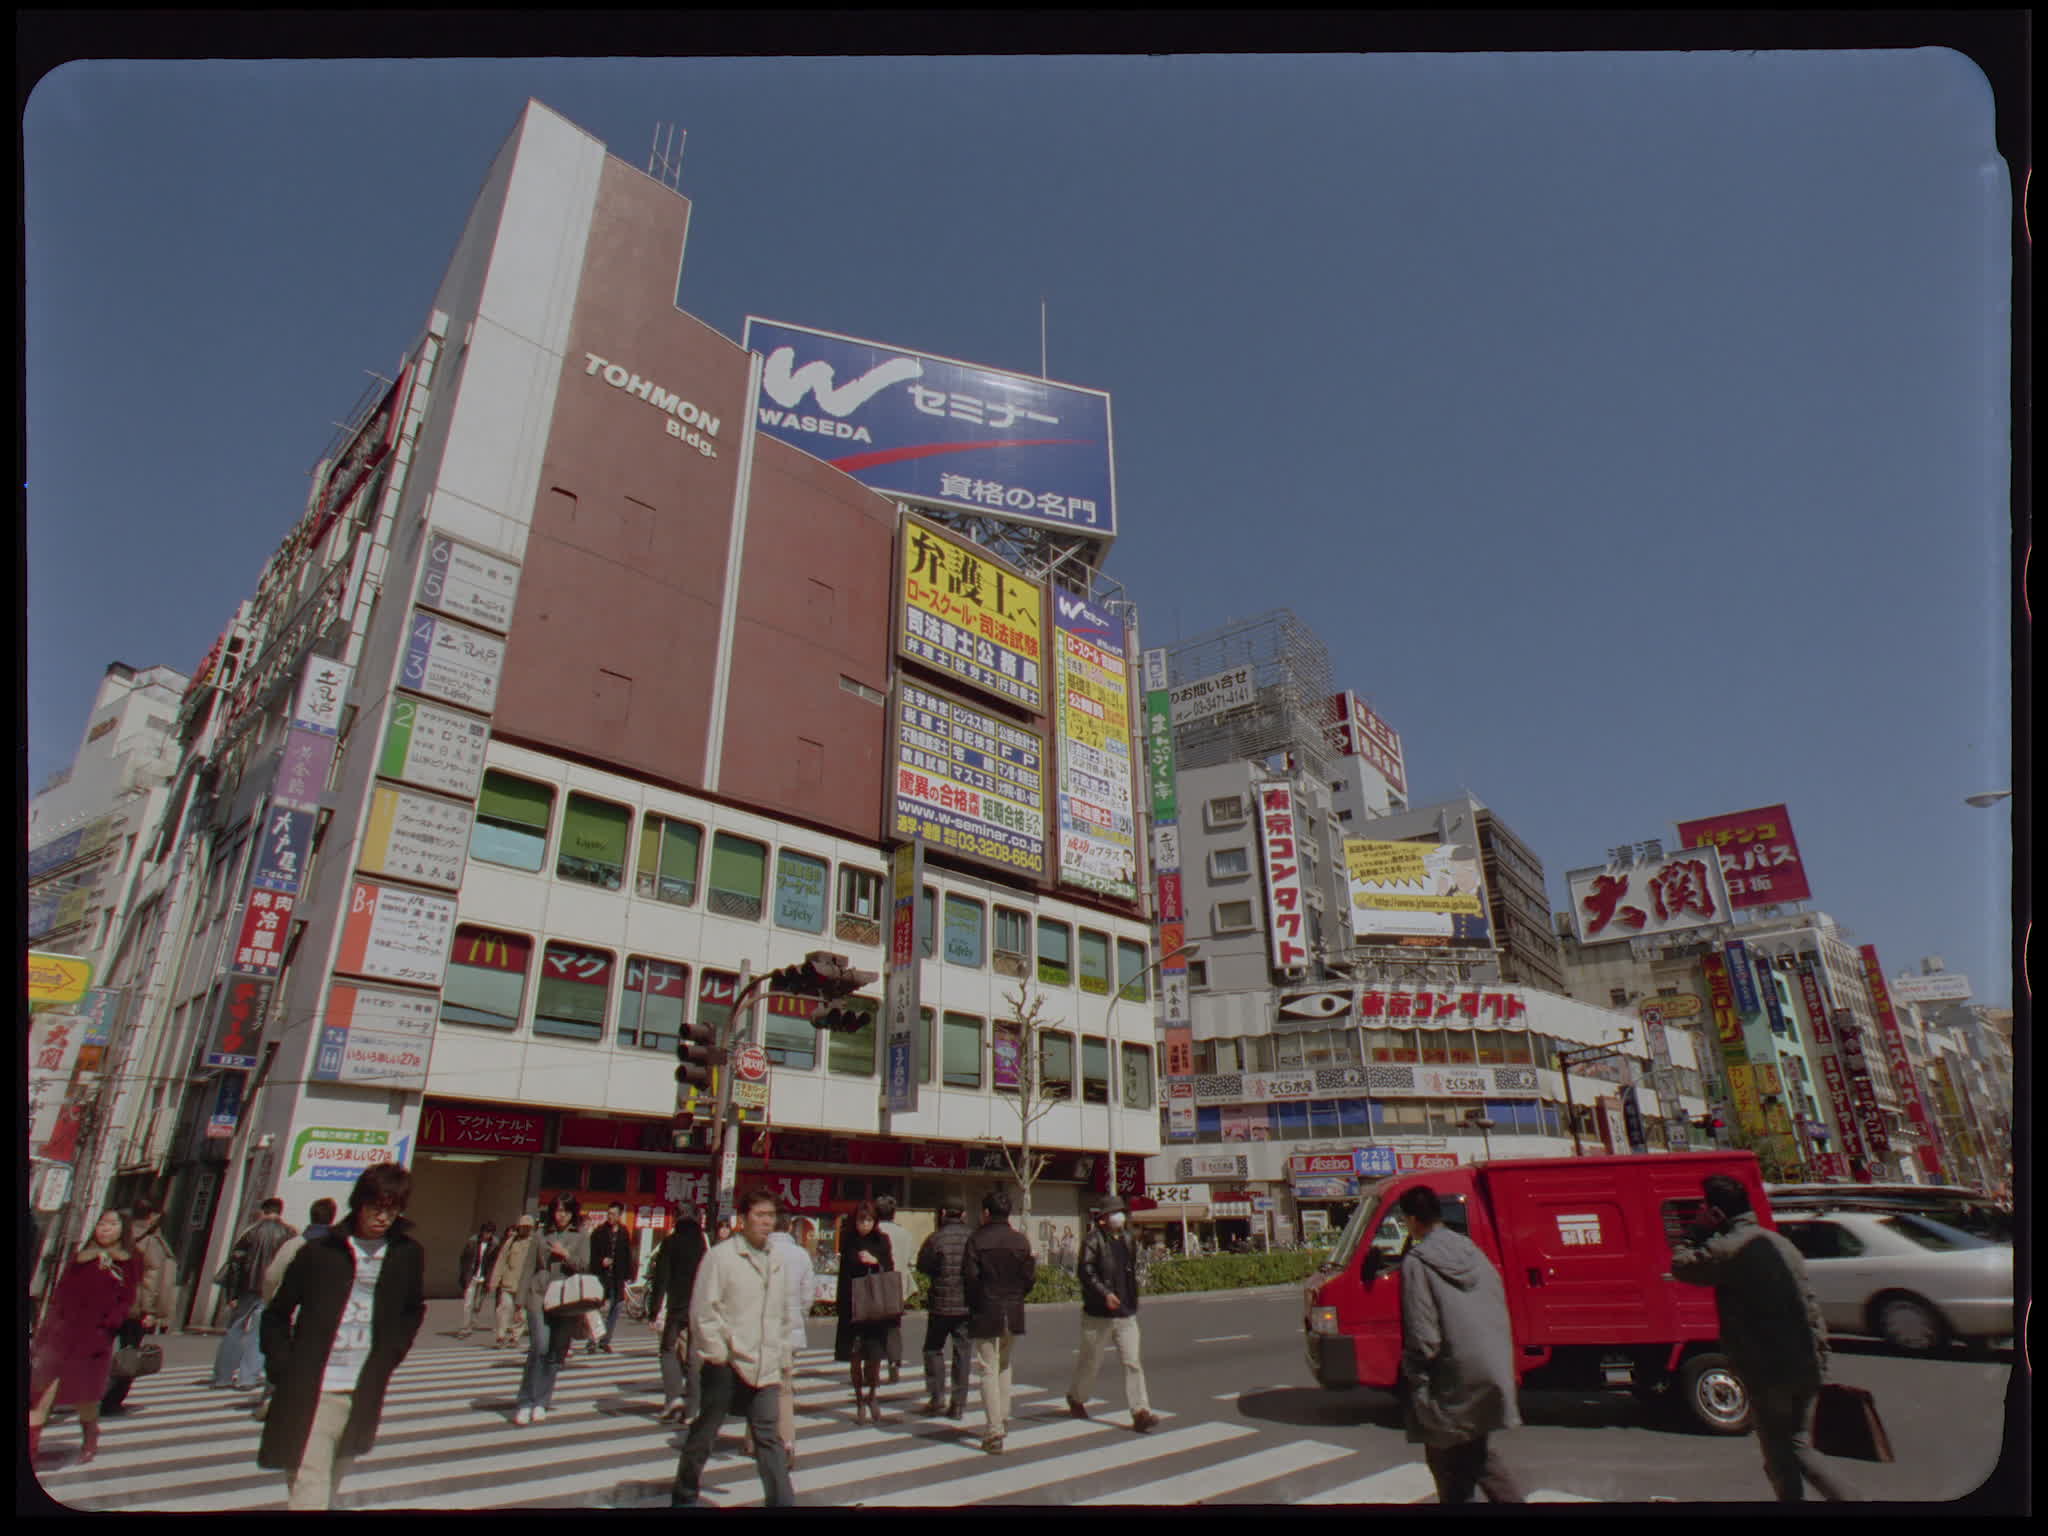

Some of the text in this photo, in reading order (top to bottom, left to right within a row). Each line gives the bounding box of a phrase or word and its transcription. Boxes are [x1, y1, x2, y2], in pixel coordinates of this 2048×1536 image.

[584, 352, 721, 437] TOHMON
[908, 385, 1059, 429] セミナー
[665, 419, 718, 459] Bldg.
[758, 407, 872, 444] WASEDA
[940, 473, 1097, 524] 資格の名門
[432, 540, 449, 564] 6
[423, 571, 443, 598] 5
[415, 621, 433, 644] 4
[405, 650, 425, 680] 3
[393, 702, 416, 729] 2
[952, 764, 996, 795] マスコミ
[897, 798, 1043, 854] www.w-seminar.co.jp
[1695, 822, 1778, 849] パチンコ
[1262, 788, 1305, 965] 東京コンタクト
[353, 887, 376, 916] B1
[1583, 859, 1717, 934] 大関
[1361, 990, 1527, 1020] 東京コンタクト
[1445, 1078, 1487, 1093] さくら水産
[456, 1114, 536, 1131] マクドナルド
[456, 1128, 537, 1145] ハンバーガー
[1360, 1151, 1390, 1162] クスリ
